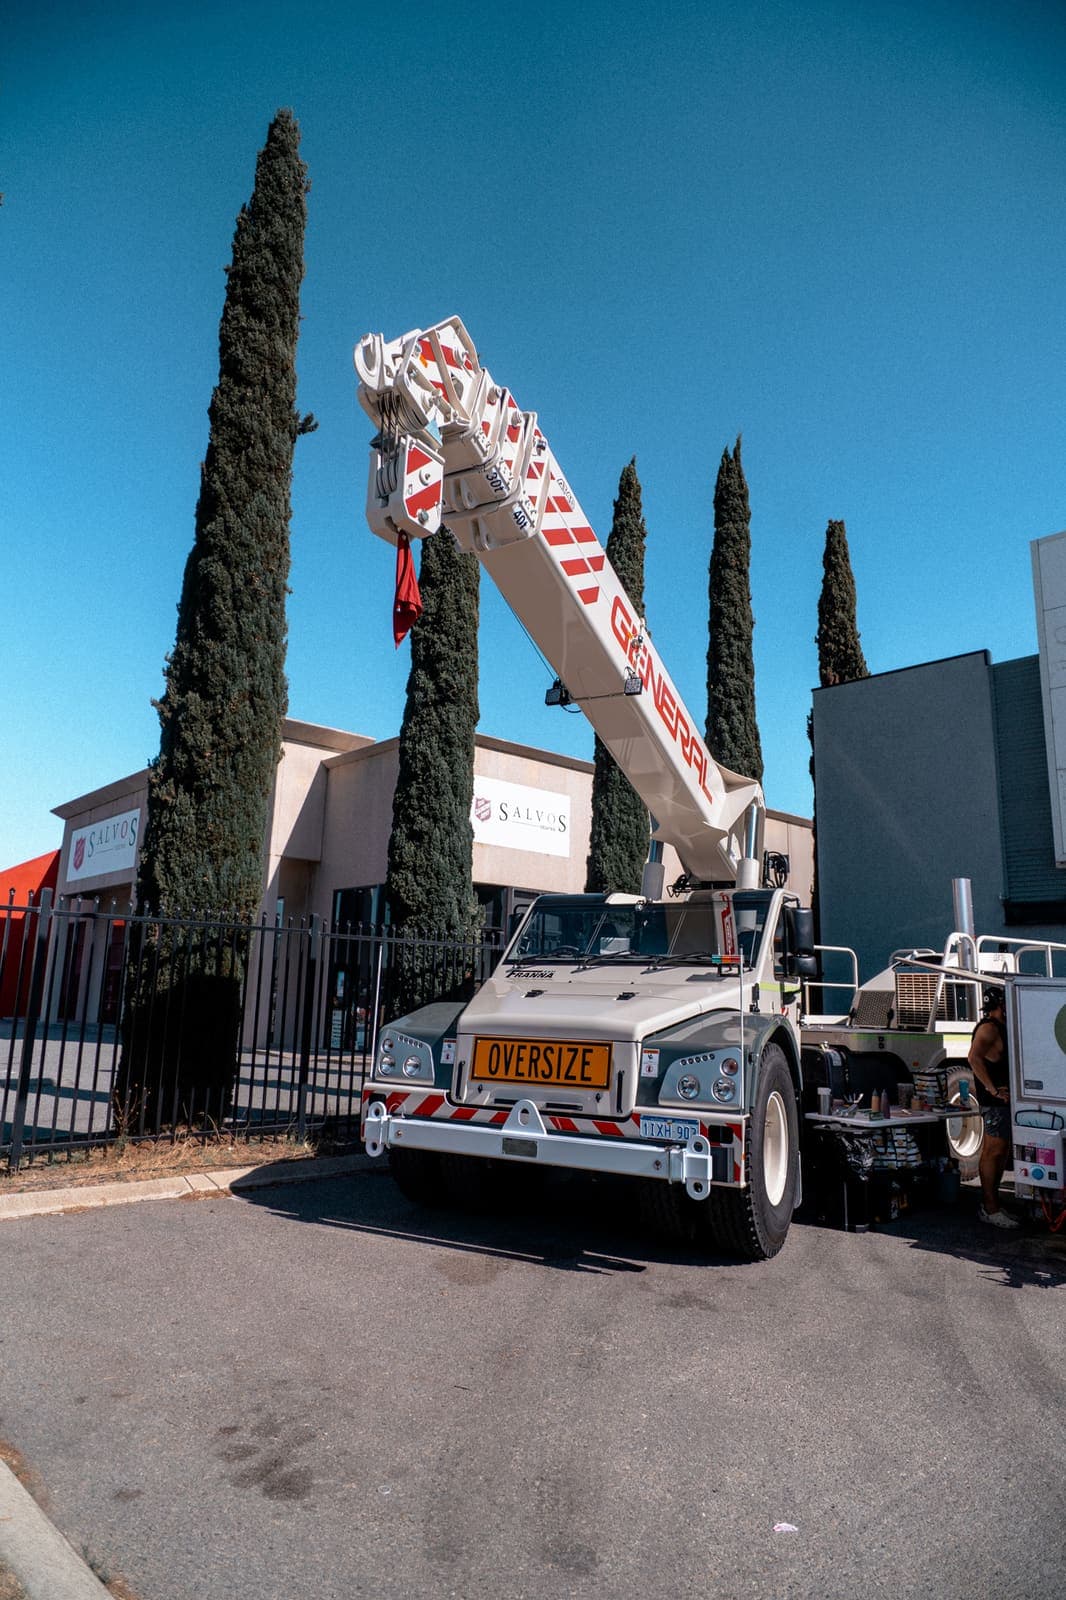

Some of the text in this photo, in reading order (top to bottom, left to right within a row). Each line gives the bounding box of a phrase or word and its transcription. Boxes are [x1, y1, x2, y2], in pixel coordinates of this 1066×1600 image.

[486, 472, 504, 492] 30t
[513, 510, 528, 530] 40t
[611, 595, 713, 805] GENERAL
[499, 802, 566, 833] SALVOS
[87, 817, 138, 858] SALVOS
[505, 969, 554, 979] FRANNA
[488, 1043, 594, 1081] OVERSIZE
